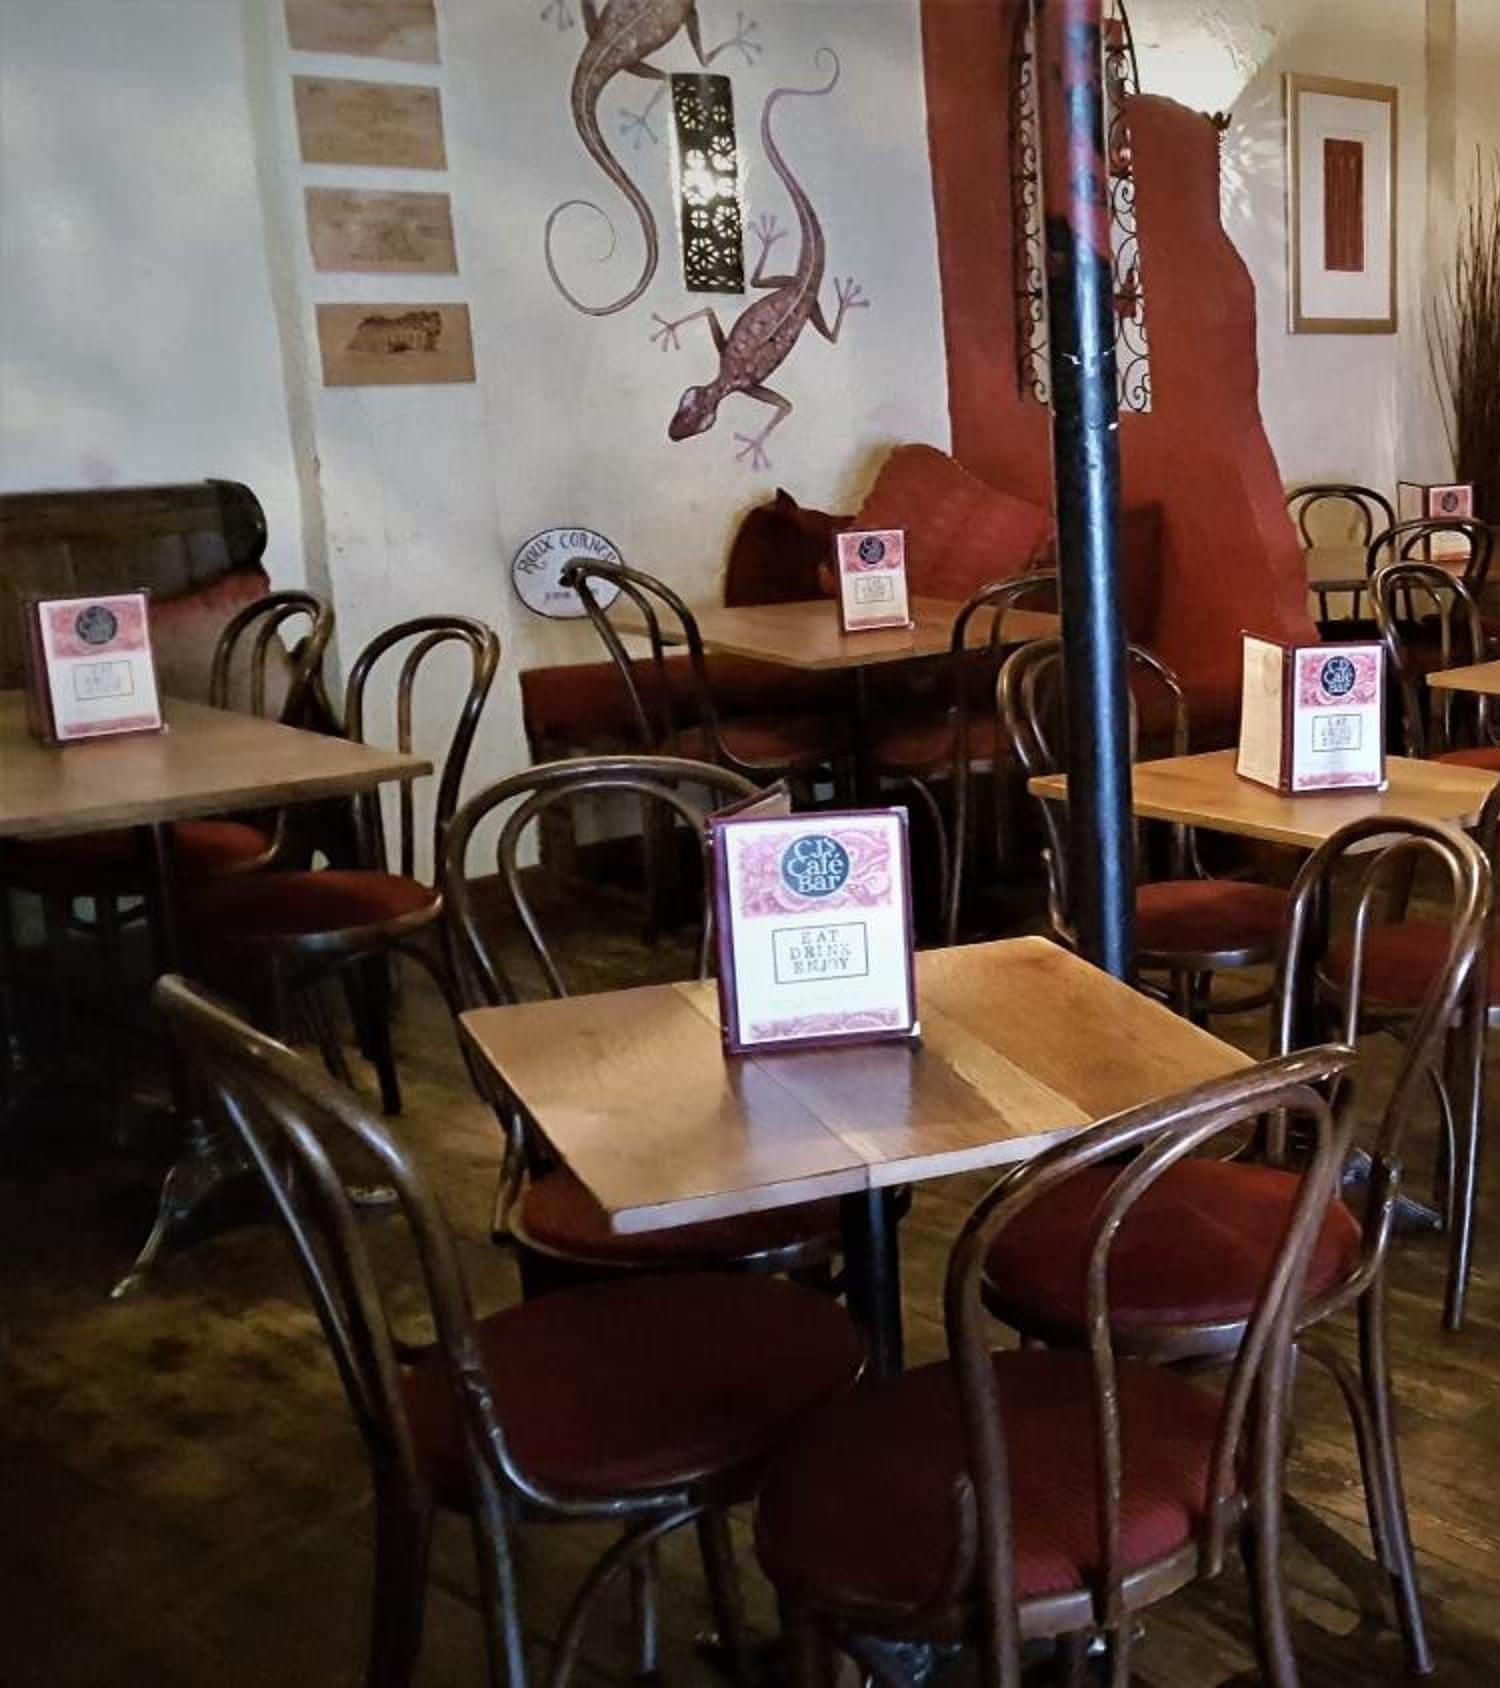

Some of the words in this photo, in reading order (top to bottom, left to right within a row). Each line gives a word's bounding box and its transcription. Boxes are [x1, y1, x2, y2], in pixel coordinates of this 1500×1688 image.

[787, 852, 844, 877] Café
[799, 875, 841, 893] Bar
[800, 929, 840, 945] EAT
[789, 944, 851, 961] DRINK
[792, 957, 848, 975] ENJOY
